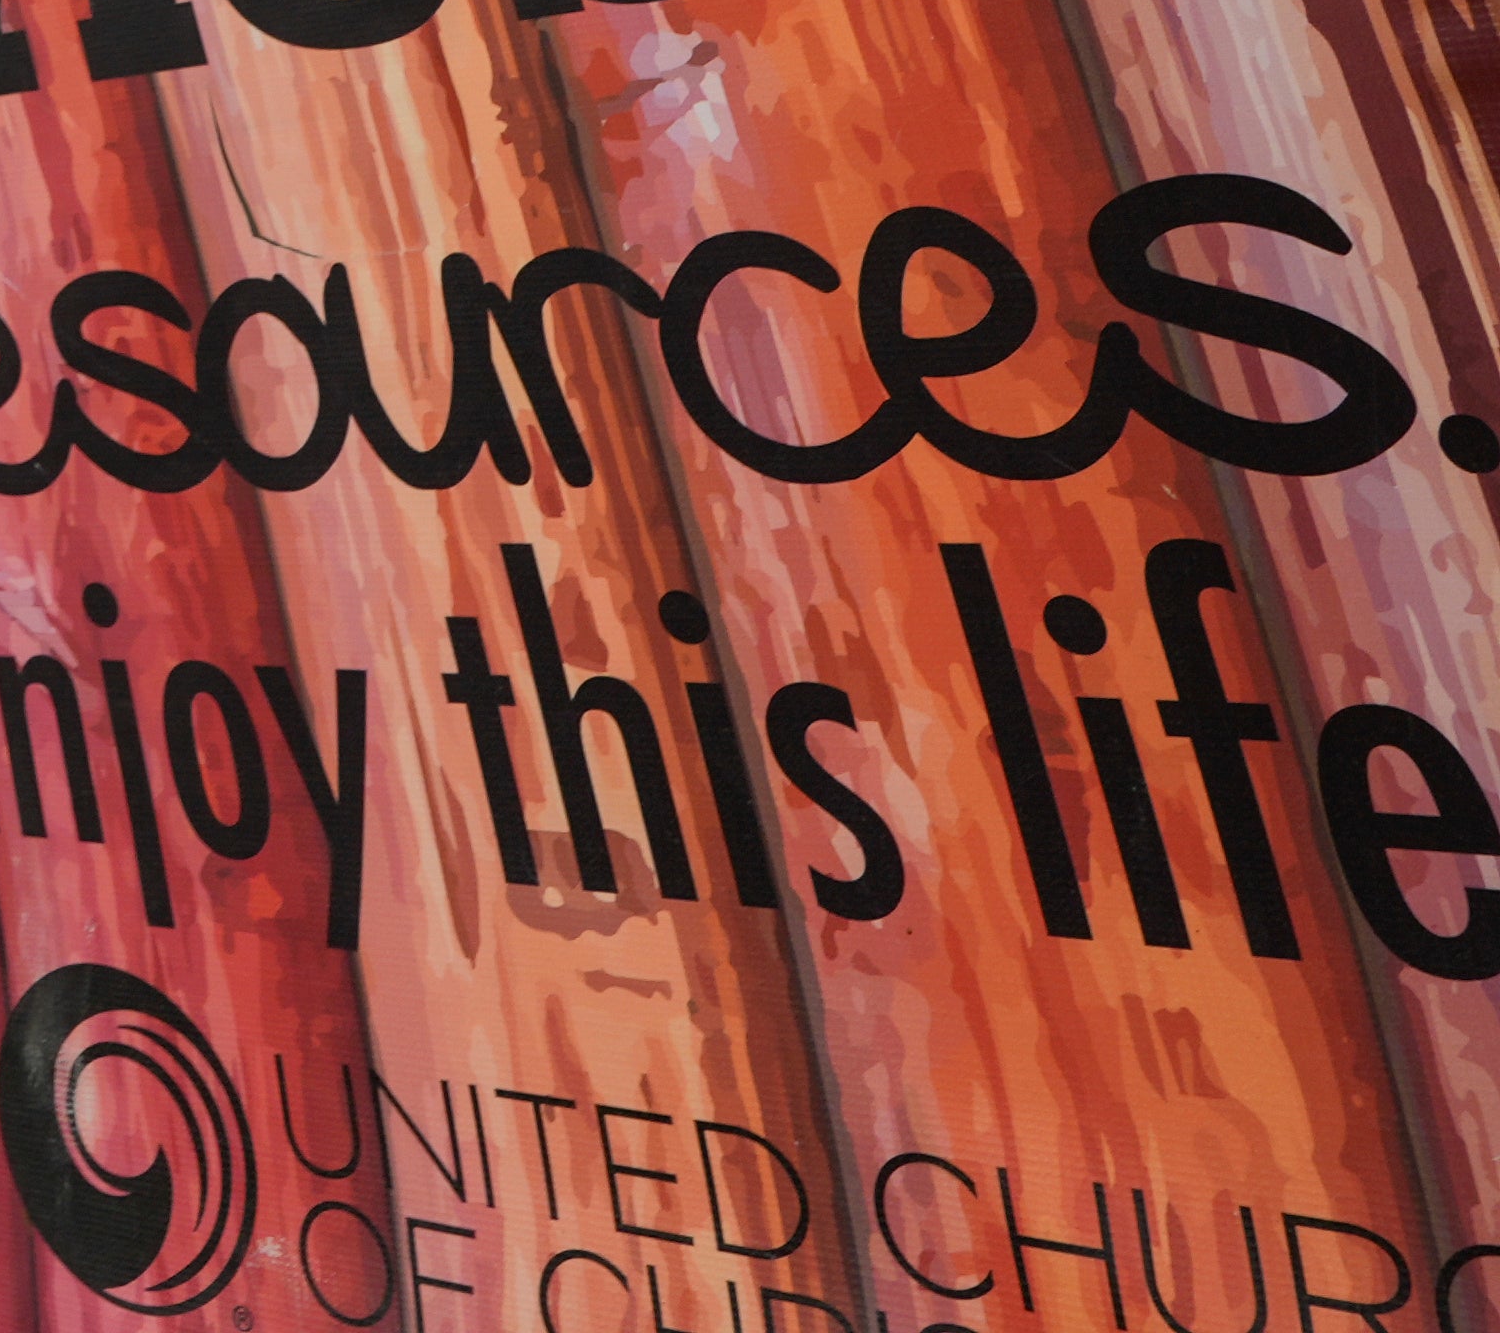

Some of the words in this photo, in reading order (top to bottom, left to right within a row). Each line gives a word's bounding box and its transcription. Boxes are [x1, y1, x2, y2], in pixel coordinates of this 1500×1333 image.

[442, 543, 905, 922] this
[937, 538, 1500, 981] life
[276, 1054, 811, 1261] UNITED
[300, 1200, 476, 1333] OF
